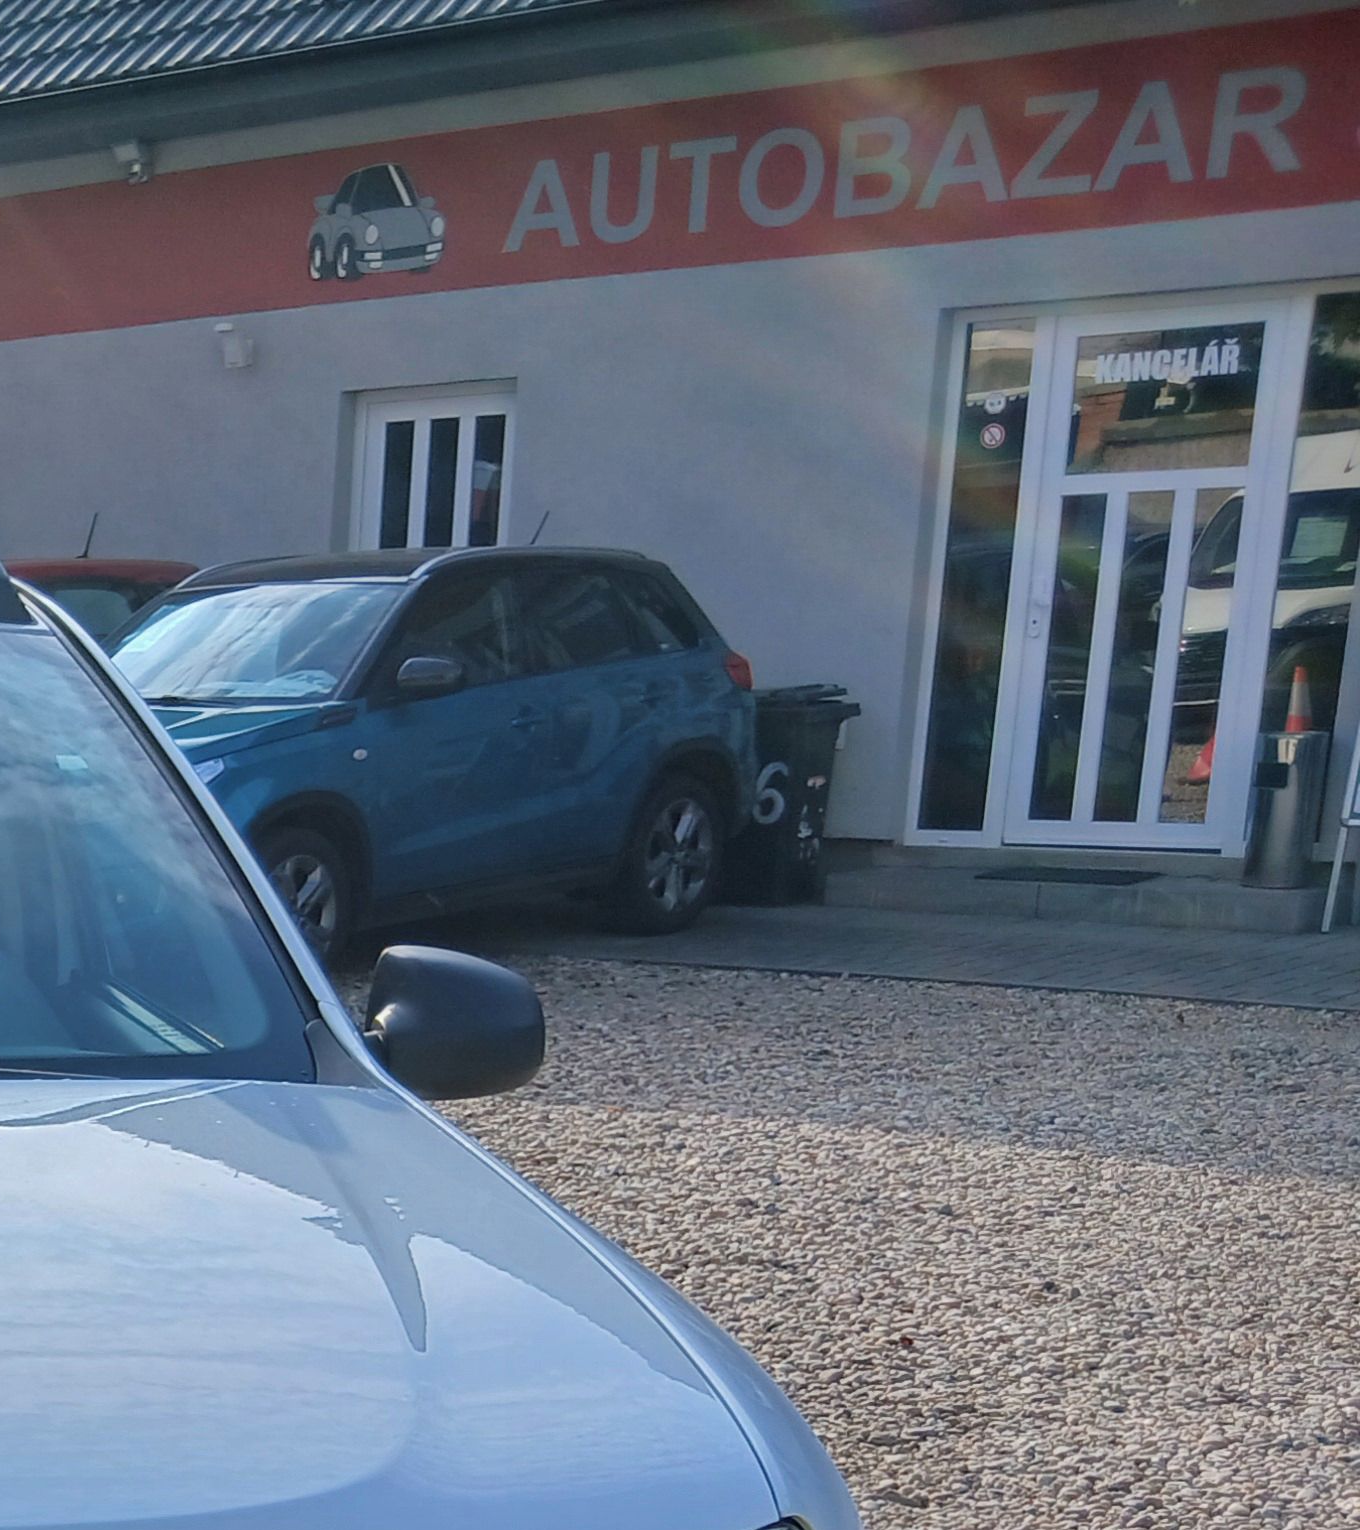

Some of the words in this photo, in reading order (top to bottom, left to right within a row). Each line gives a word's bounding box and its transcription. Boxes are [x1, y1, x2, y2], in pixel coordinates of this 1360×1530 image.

[501, 66, 1308, 253] AUTOBAZAR
[1094, 337, 1241, 384] KANCELÁŘ
[752, 762, 789, 824] 6
